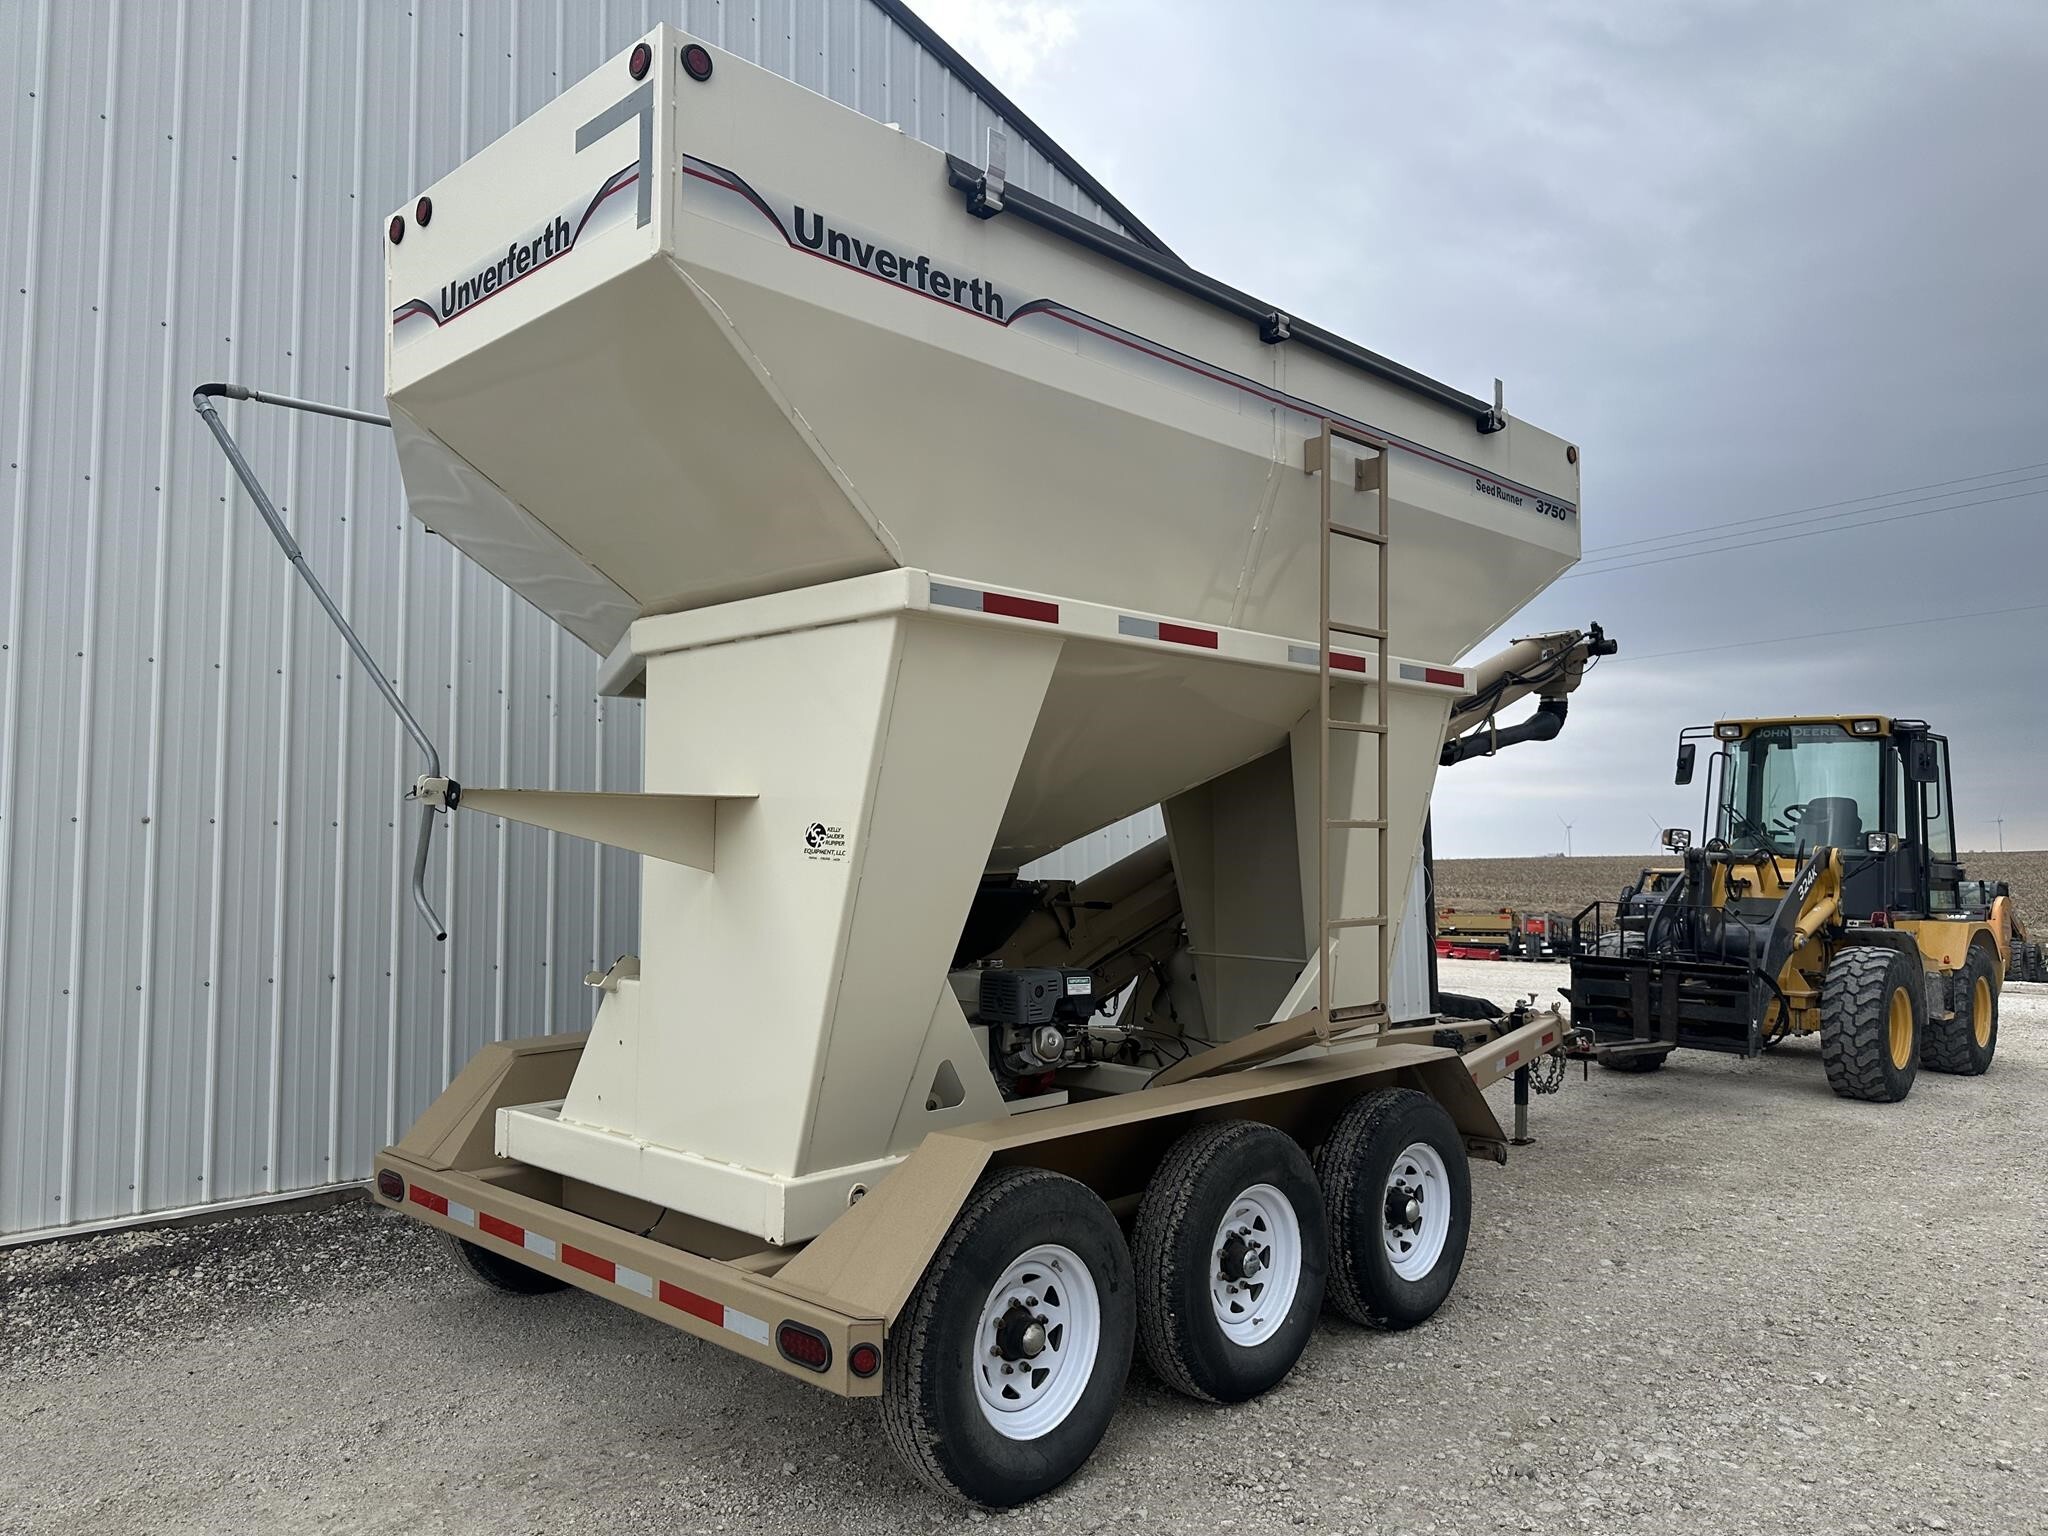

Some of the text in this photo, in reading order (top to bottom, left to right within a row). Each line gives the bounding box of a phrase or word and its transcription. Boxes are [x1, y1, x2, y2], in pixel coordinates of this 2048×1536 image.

[441, 215, 570, 318] Unverferth
[794, 205, 1004, 319] Unverferth
[1536, 499, 1566, 521] 3750
[1756, 727, 1839, 738] JOHN DEERE
[1798, 864, 1818, 901] 324K
